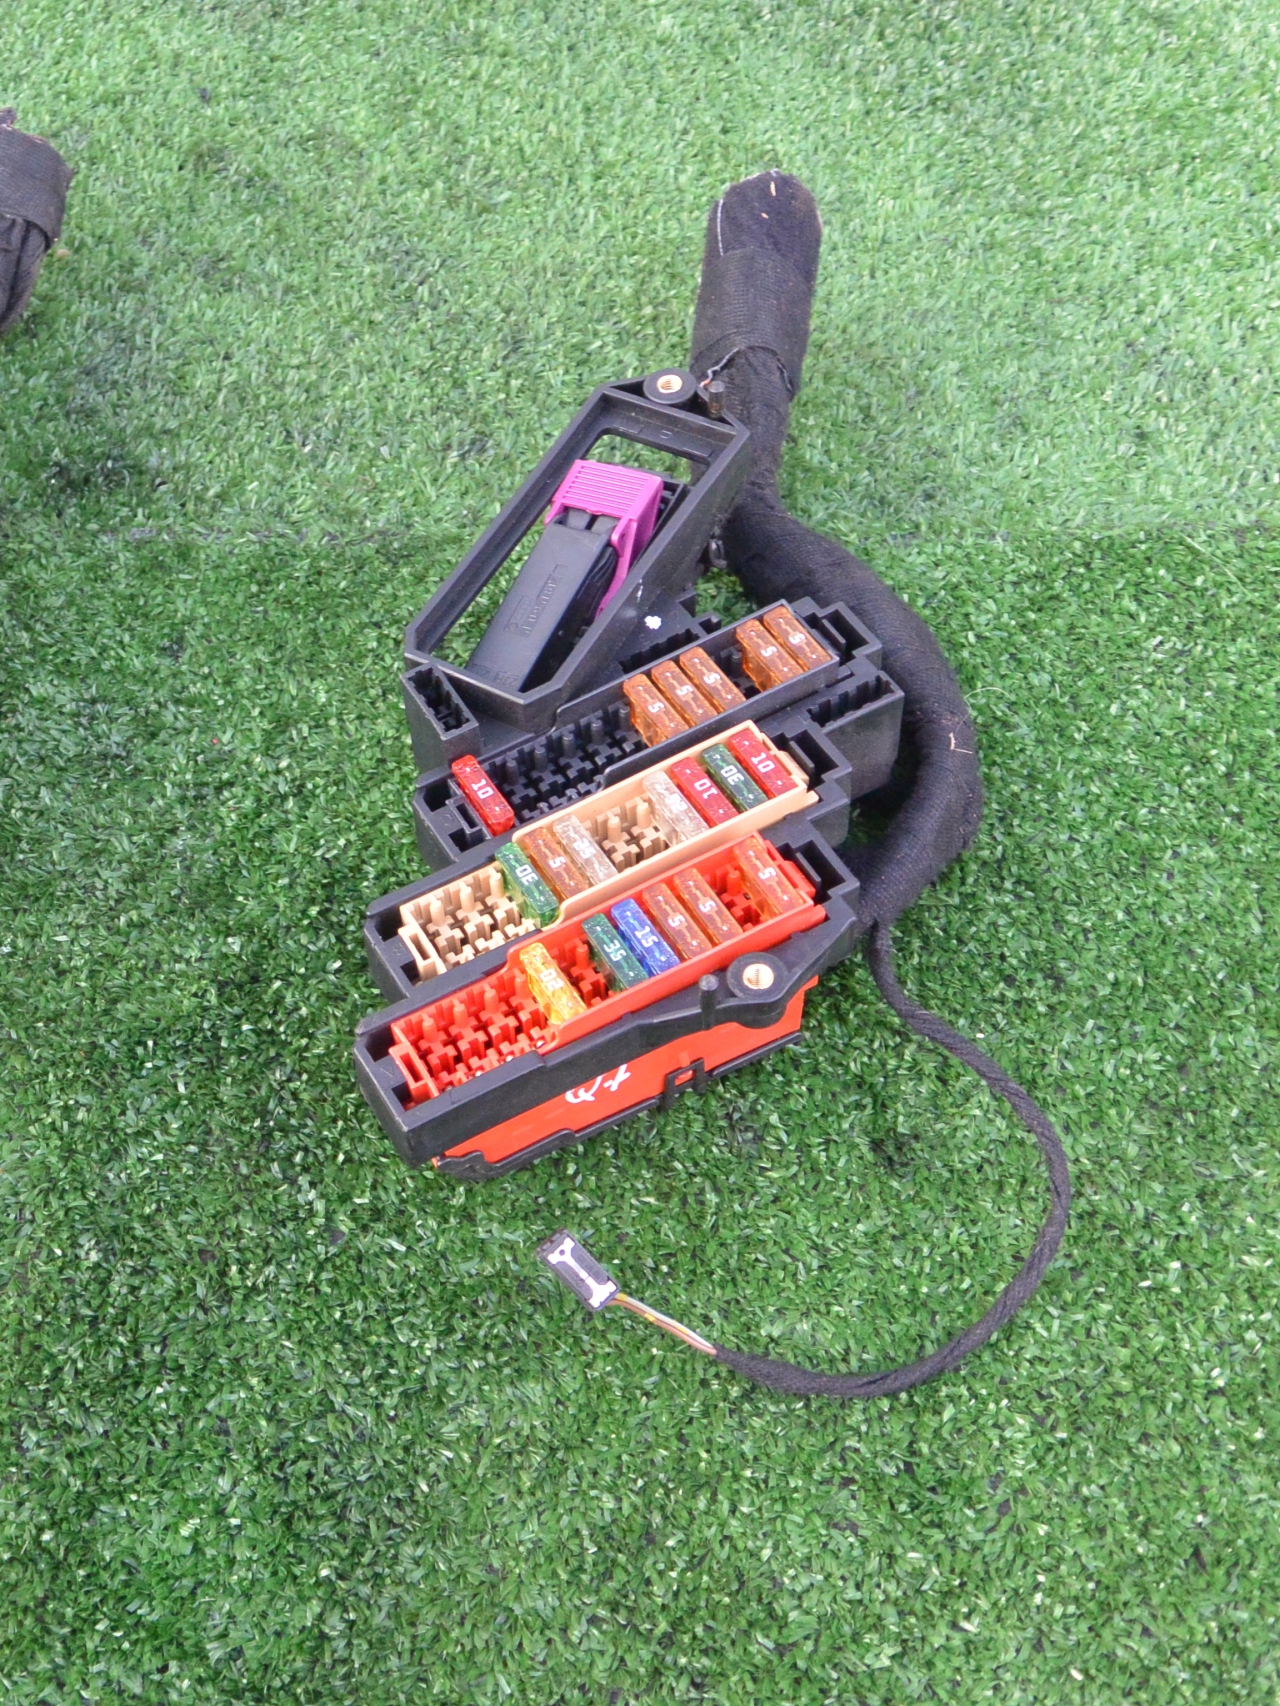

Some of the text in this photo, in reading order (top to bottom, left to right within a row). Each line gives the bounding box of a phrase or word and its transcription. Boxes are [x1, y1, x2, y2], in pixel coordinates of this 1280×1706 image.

[789, 633, 806, 645] 5
[761, 645, 777, 657] 5
[704, 672, 720, 685] 5
[676, 684, 693, 696] 5
[648, 701, 665, 713] 5
[751, 752, 775, 773] 10
[720, 764, 745, 786] 30
[471, 778, 494, 799] 10
[693, 778, 718, 799] 10
[549, 856, 567, 868] 5
[515, 864, 539, 885] 30
[758, 868, 777, 880] 5
[698, 899, 717, 913] 5
[668, 914, 686, 928] 5
[634, 925, 659, 948] 15
[603, 939, 627, 962] 35
[539, 968, 565, 992] 20
